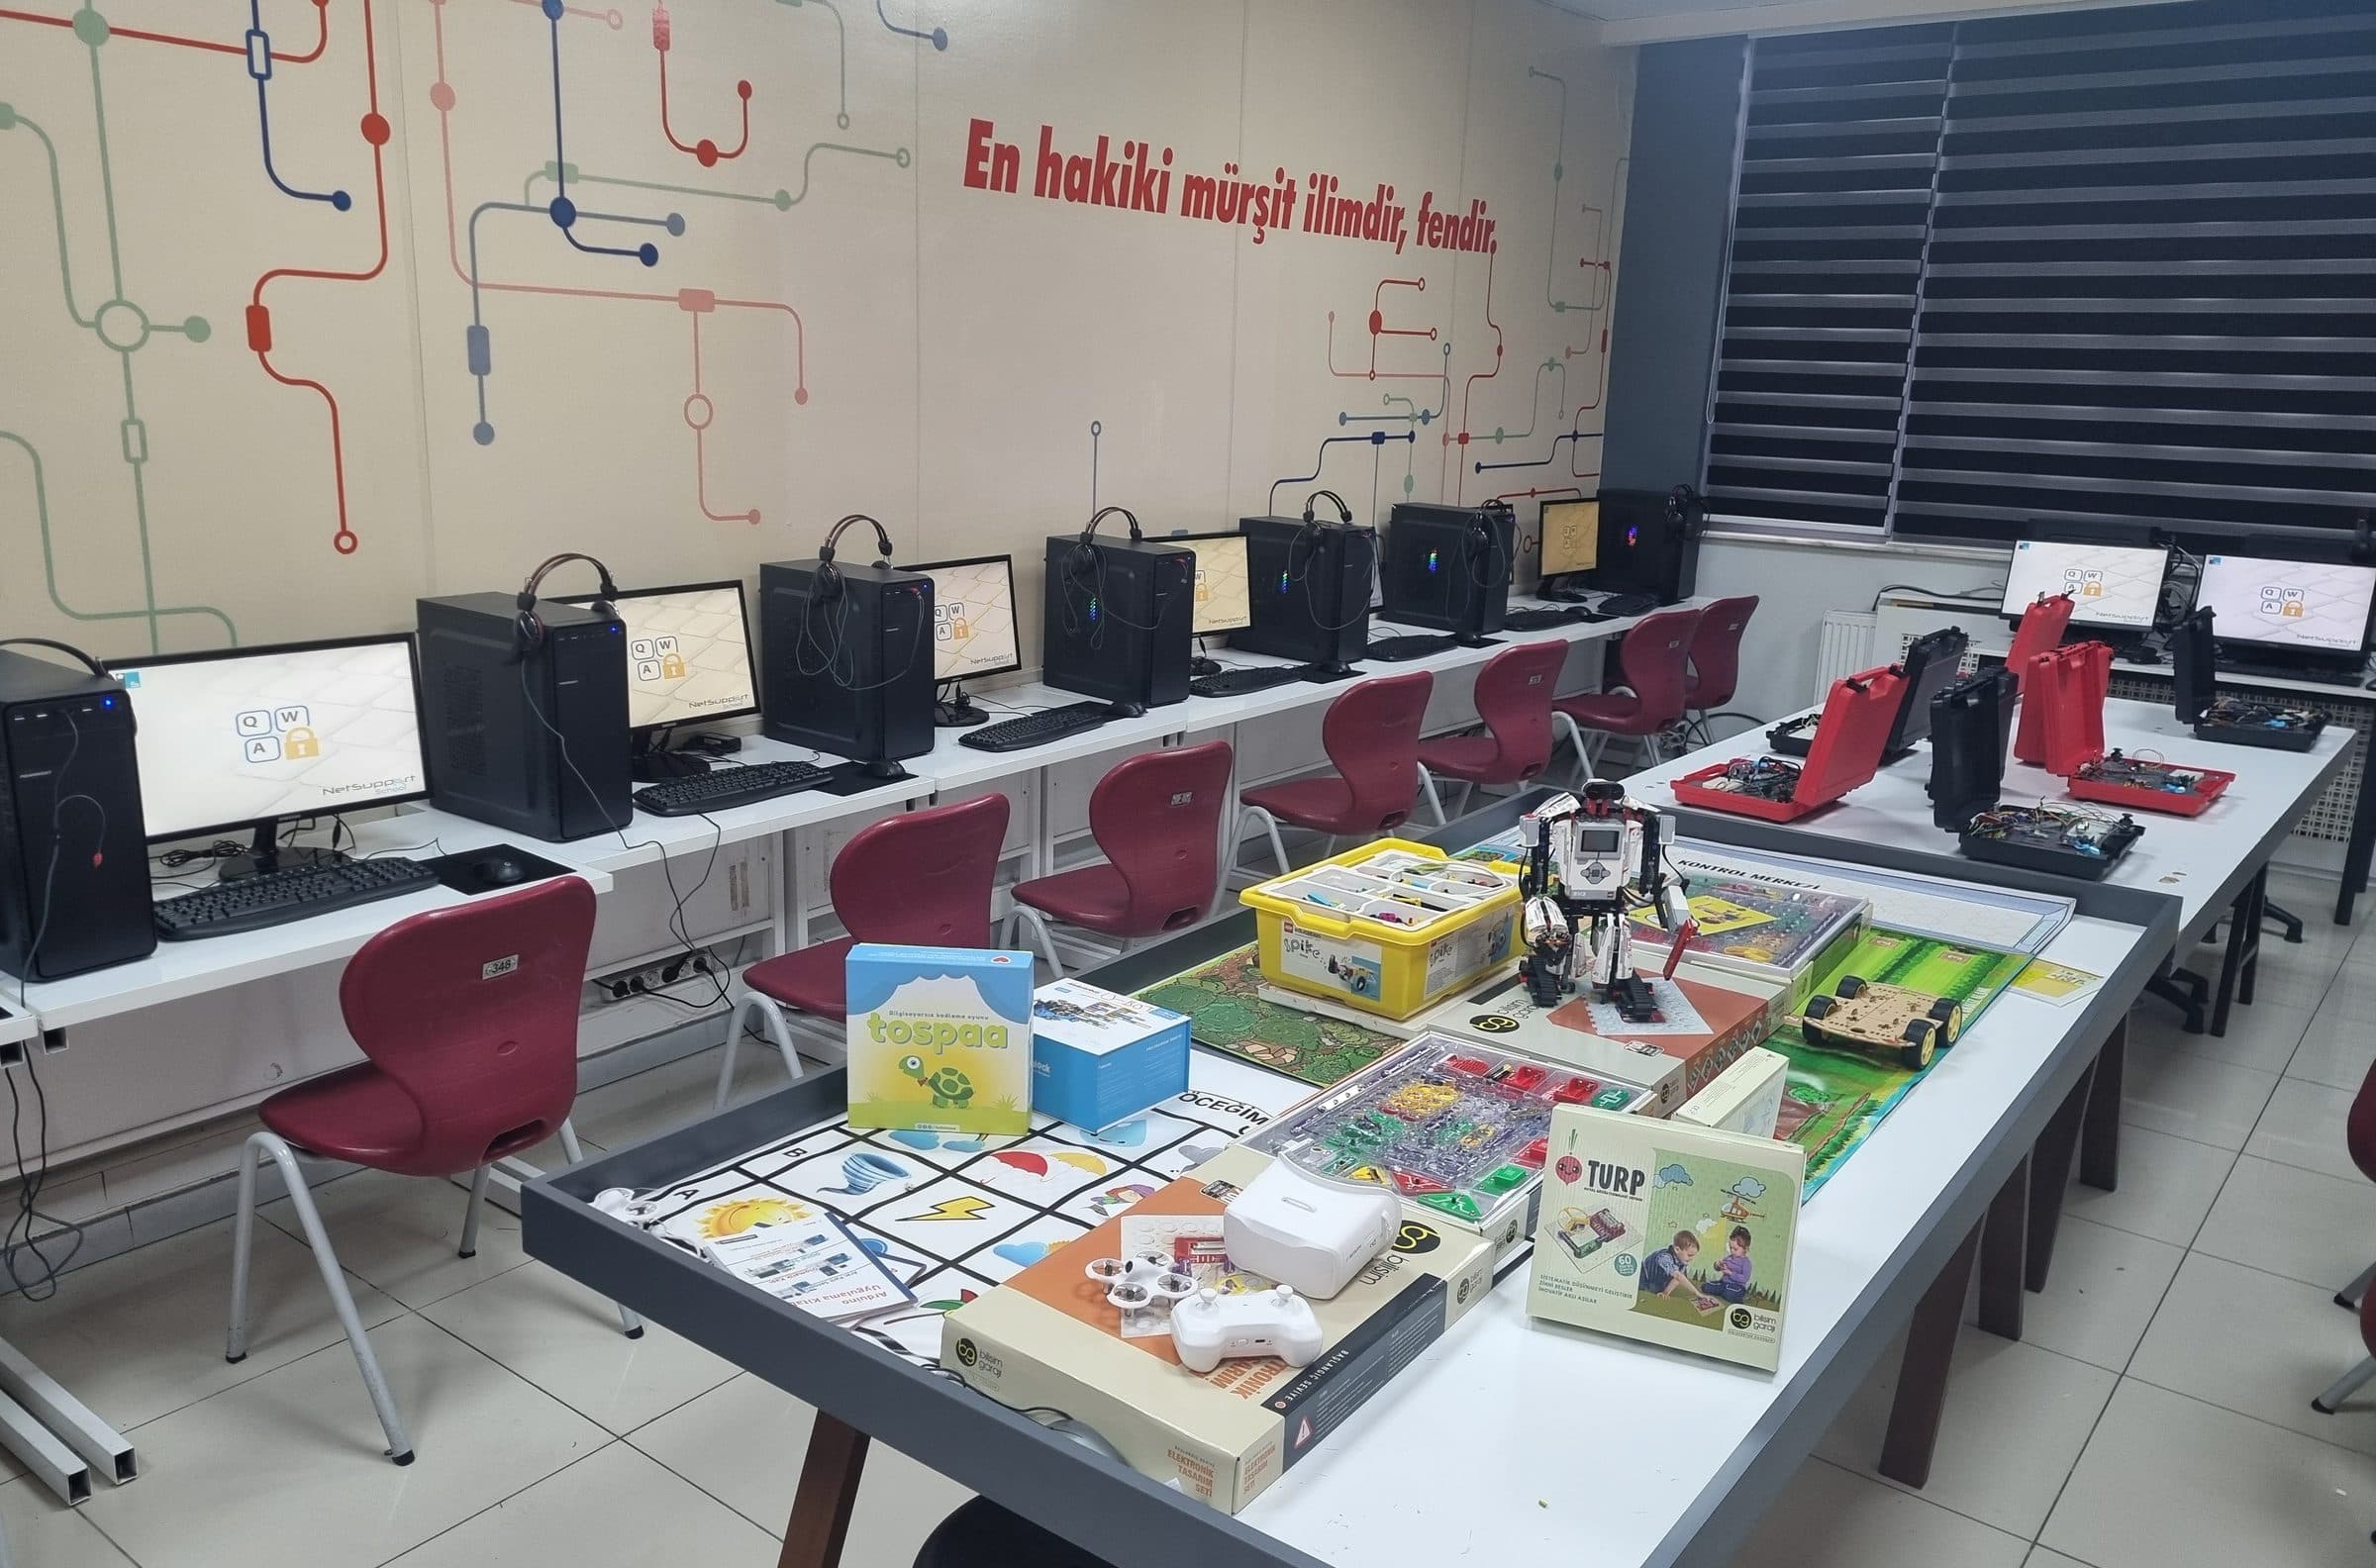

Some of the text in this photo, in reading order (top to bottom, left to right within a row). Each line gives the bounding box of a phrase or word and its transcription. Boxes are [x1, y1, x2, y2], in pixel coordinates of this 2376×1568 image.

[963, 118, 1498, 254] En hakiki mürşit ilimdir, fendir.
[636, 640, 671, 653] Q W
[643, 664, 652, 674] A
[243, 711, 298, 728] Q W
[252, 742, 265, 754] A
[323, 775, 416, 795] NetSupport
[1678, 859, 1746, 878] KONTROL
[493, 959, 511, 973] 348
[866, 1012, 1009, 1054] tospaa
[782, 1147, 808, 1158] B
[1588, 1159, 1645, 1196] TURP
[673, 1189, 700, 1200] A
[1619, 1256, 1632, 1265] 60
[823, 1284, 881, 1301] Uygulama
[842, 1291, 888, 1306] Arduino
[1230, 1359, 1288, 1401] TRONİK
